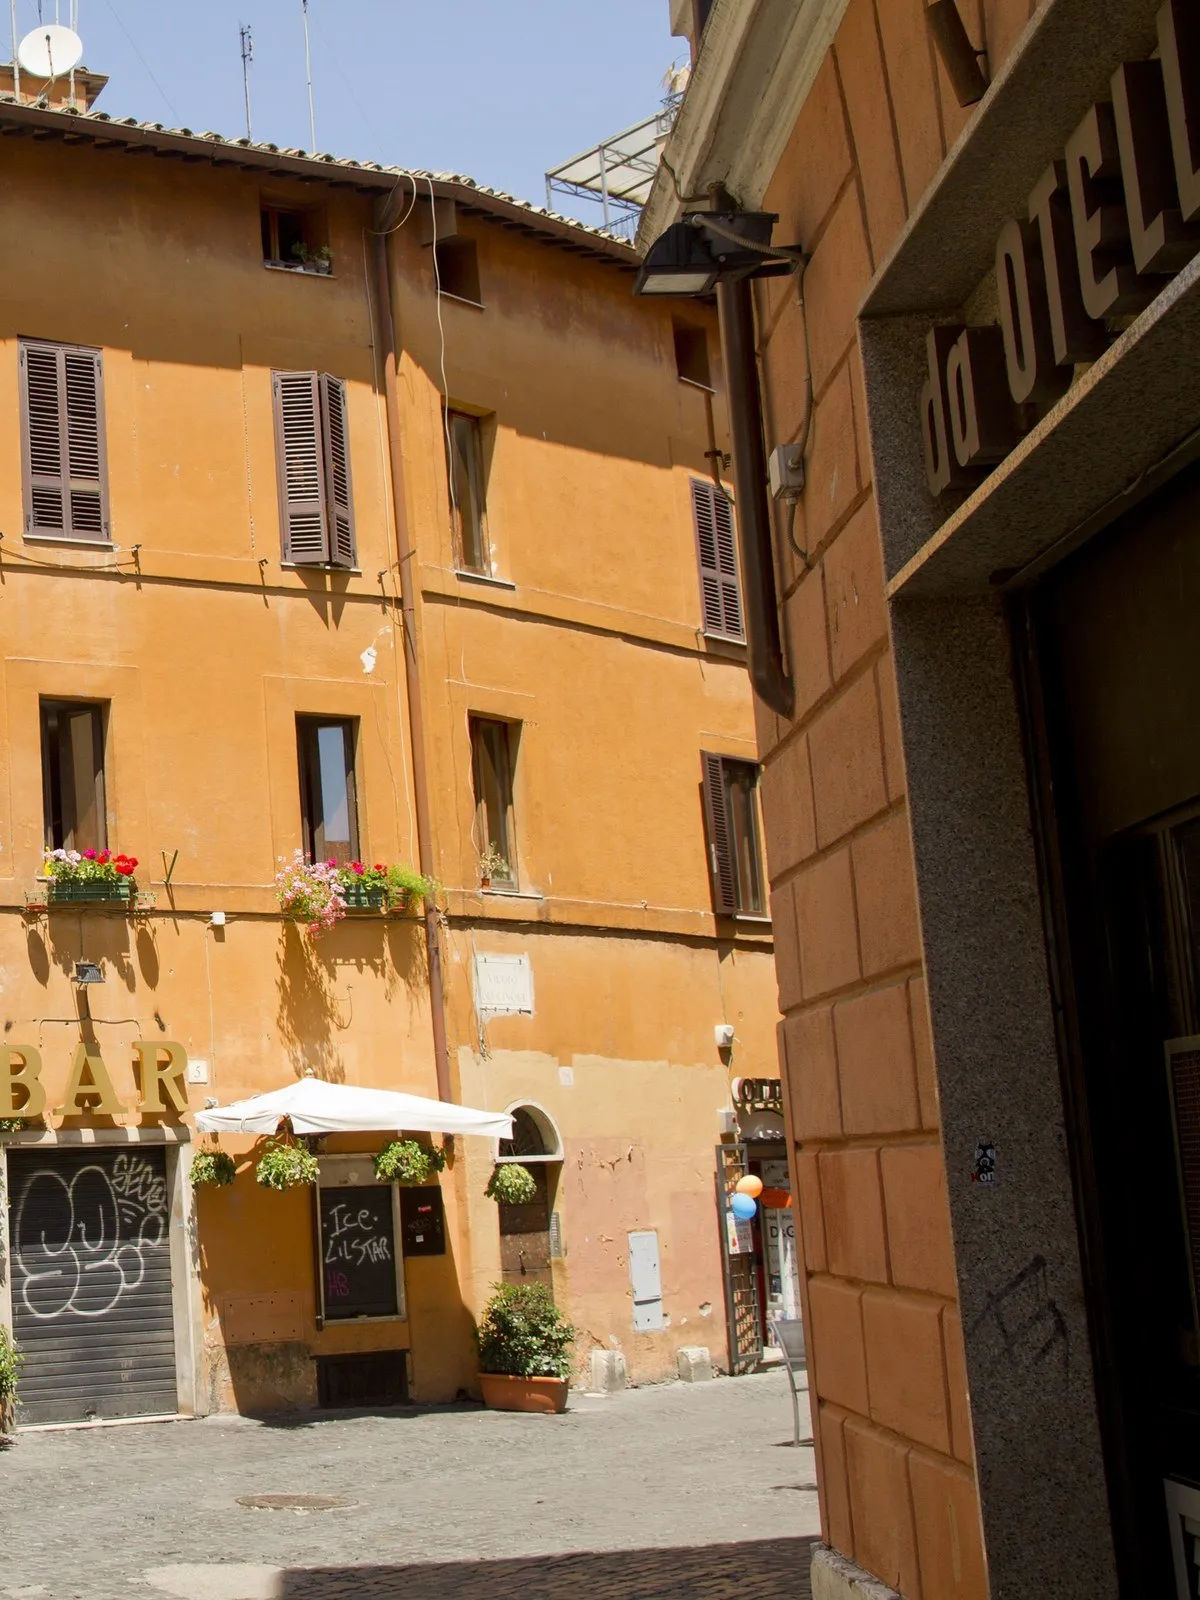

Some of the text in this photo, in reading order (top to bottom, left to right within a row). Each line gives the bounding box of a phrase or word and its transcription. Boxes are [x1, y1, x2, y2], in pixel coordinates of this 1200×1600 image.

[919, 325, 981, 498] da
[193, 1064, 201, 1079] 5
[329, 1203, 373, 1238] Ice
